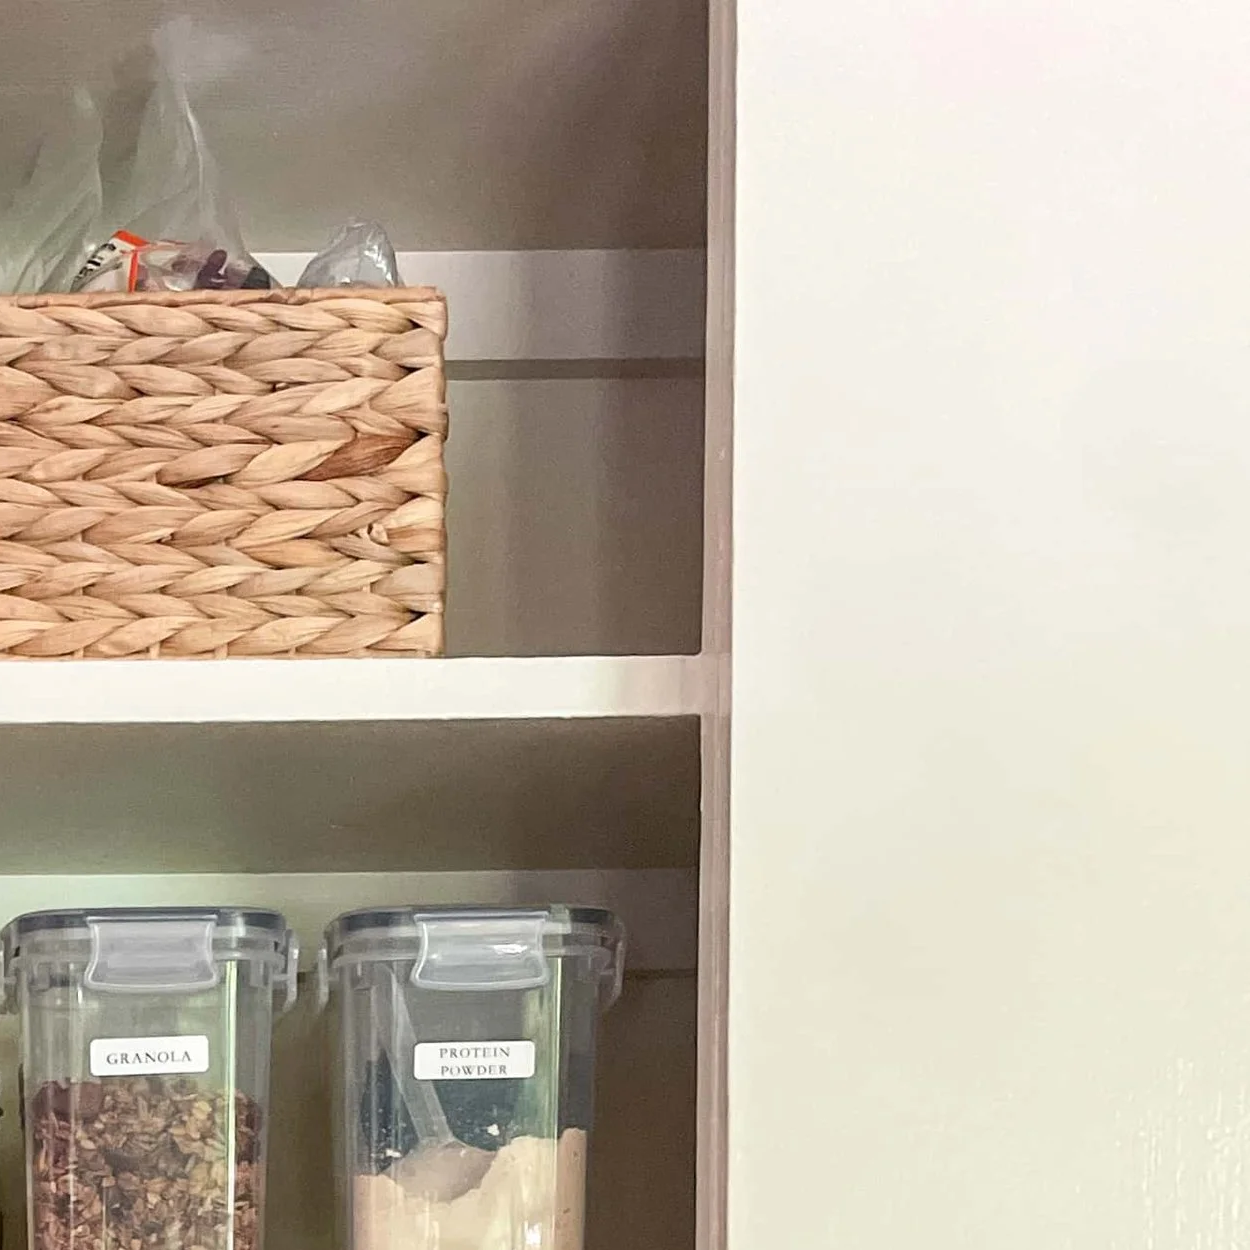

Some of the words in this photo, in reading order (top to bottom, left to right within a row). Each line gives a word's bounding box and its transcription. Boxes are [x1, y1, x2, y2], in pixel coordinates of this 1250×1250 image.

[107, 1050, 192, 1066] GRANOLA
[439, 1046, 511, 1060] PROTEIN
[440, 1064, 508, 1077] POWDER
